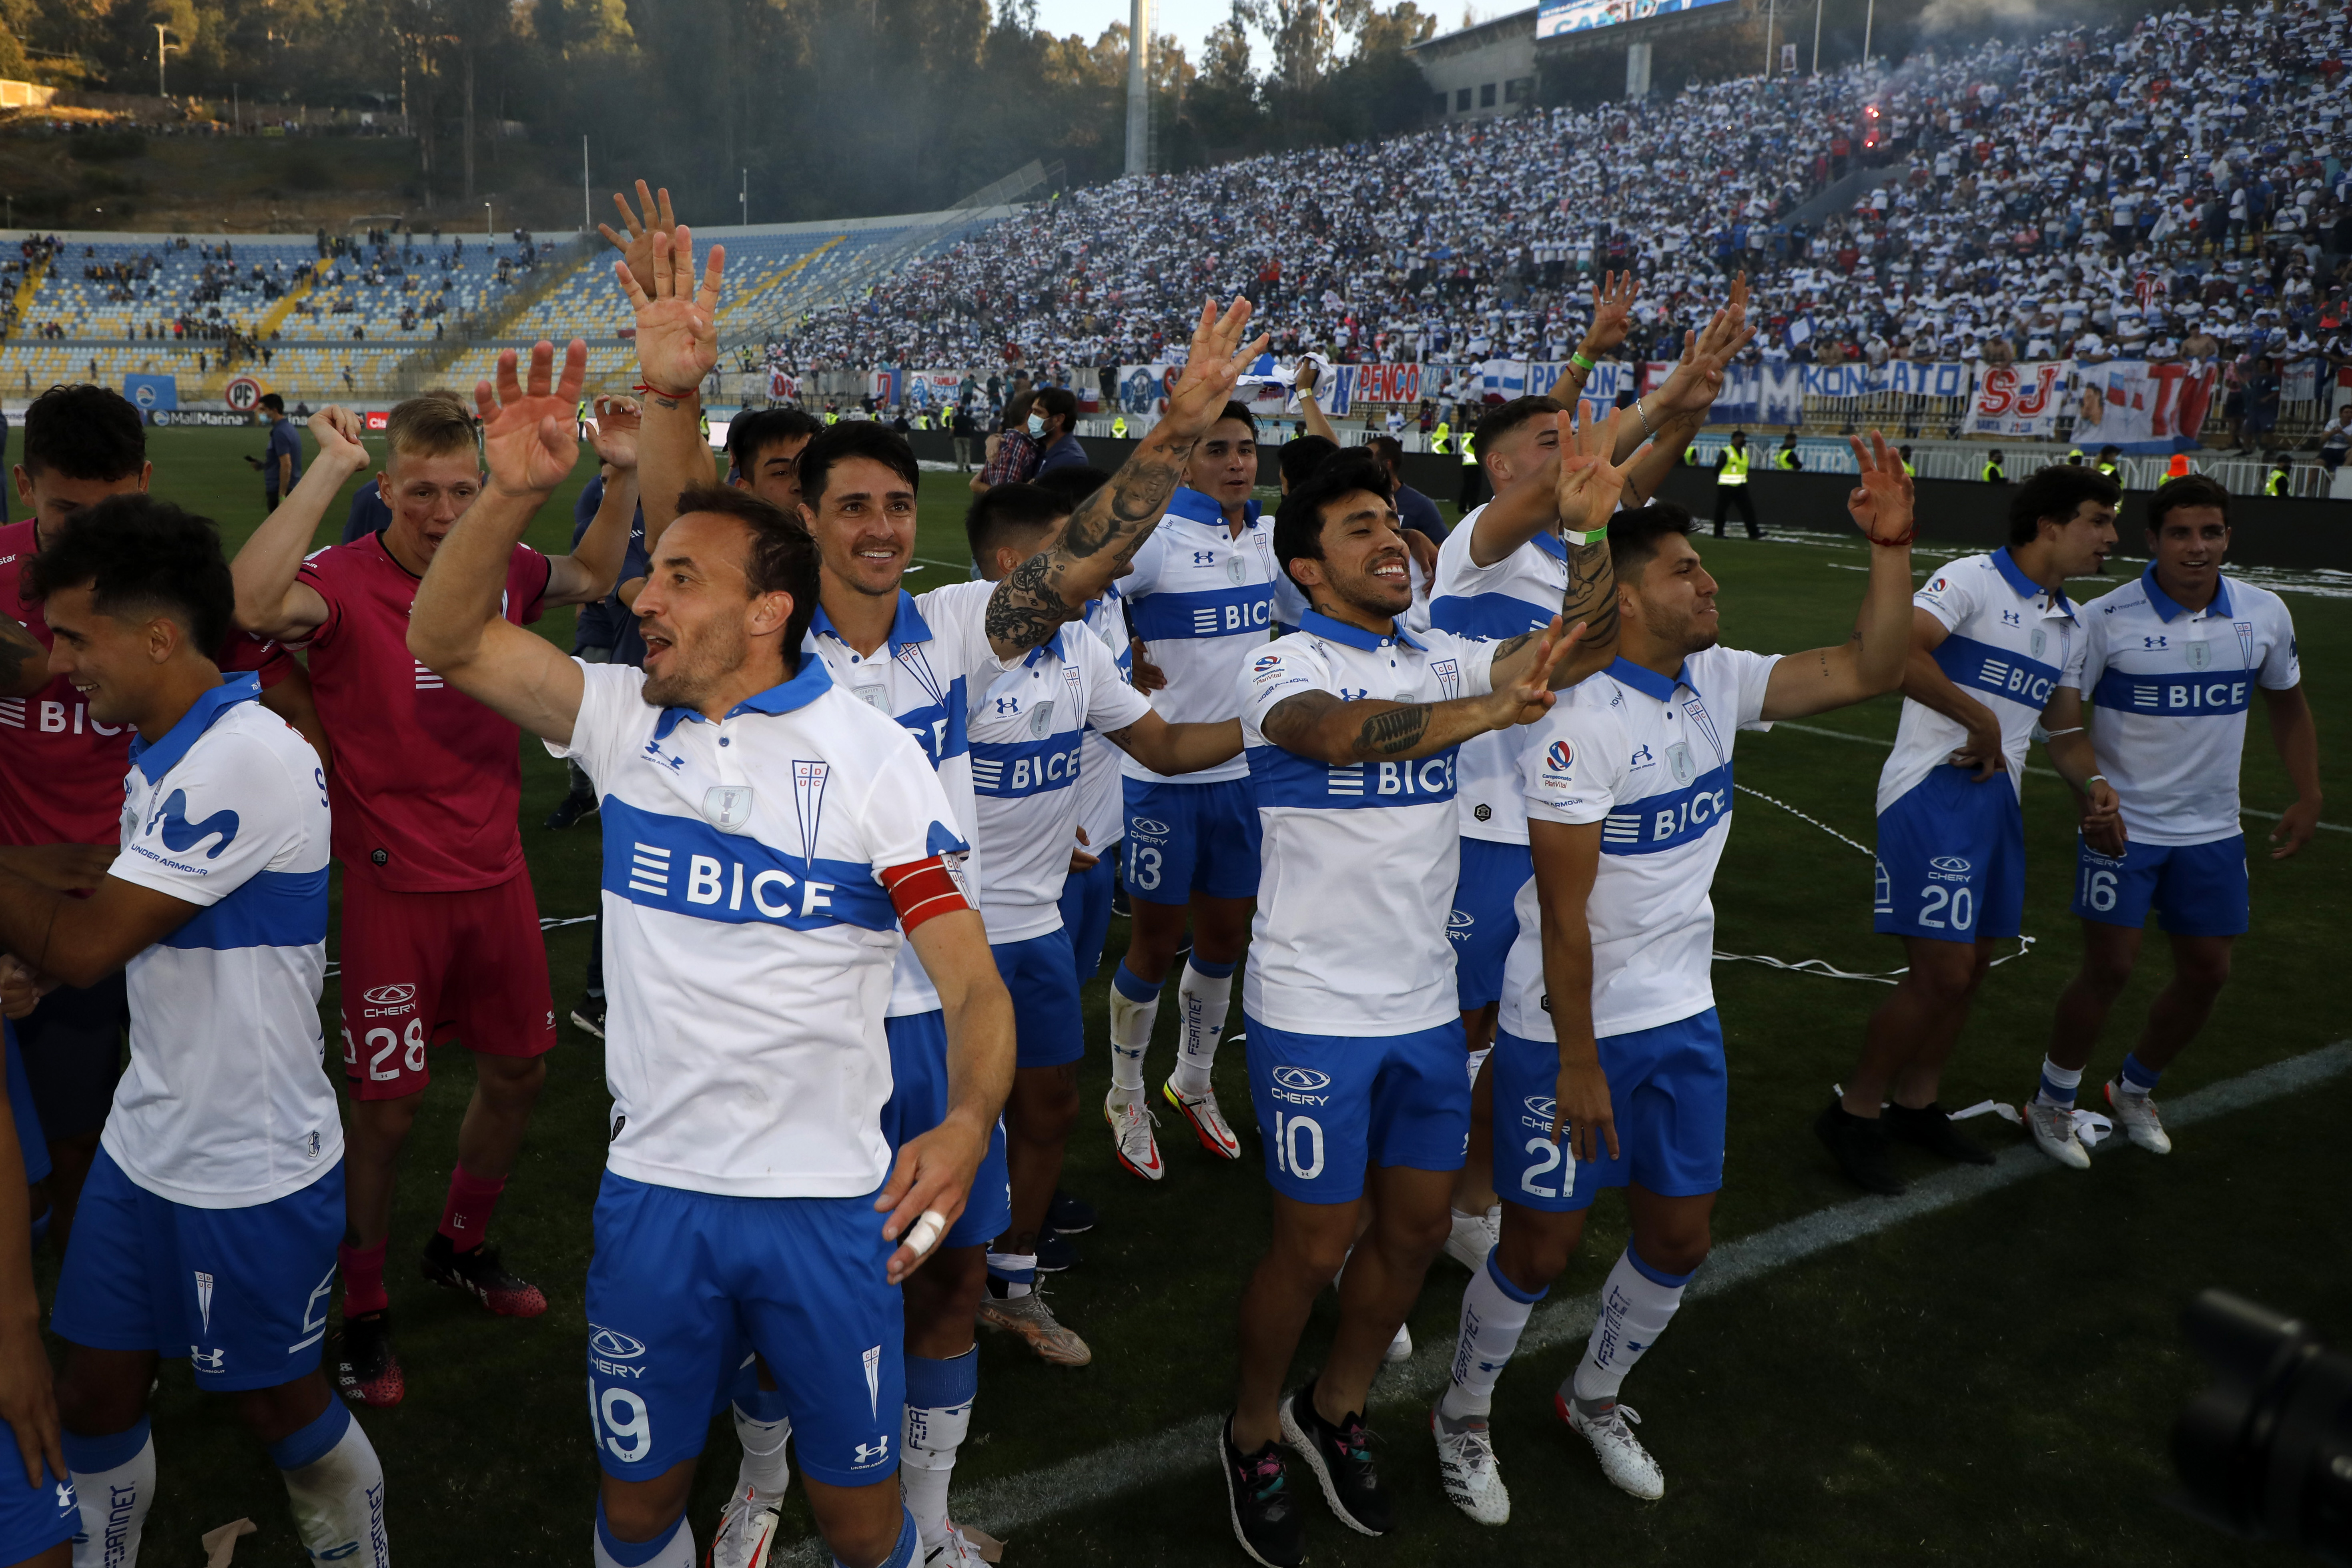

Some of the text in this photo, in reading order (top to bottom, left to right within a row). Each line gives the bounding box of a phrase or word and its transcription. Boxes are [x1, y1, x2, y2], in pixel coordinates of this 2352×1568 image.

[1358, 363, 1419, 402] PENCO
[1977, 363, 2061, 418] SJ
[2118, 599, 2147, 610] movistar
[1256, 672, 1281, 686] PlanVital
[2169, 682, 2246, 708] BICE
[1011, 746, 1081, 790] BICE
[1377, 754, 1454, 794] BICE
[1542, 773, 1572, 782] Campeonato
[1544, 780, 1567, 789] PlanVital
[1653, 787, 1726, 842] BICE
[1130, 830, 1168, 847] CHERY
[131, 843, 208, 876] UNDER ARMOUR
[1129, 842, 1163, 891] 13
[1928, 871, 1971, 883] CHERY
[687, 854, 836, 918] BICE
[2082, 867, 2117, 912] 16
[1919, 884, 1973, 931] 20
[364, 999, 416, 1018] CHERY
[365, 1017, 425, 1081] 28
[1271, 1087, 1330, 1107] CHERY
[1275, 1110, 1324, 1180] 10
[1522, 1137, 1576, 1198] 21
[589, 1376, 651, 1462] 19
[871, 1455, 889, 1467] ARMOUR
